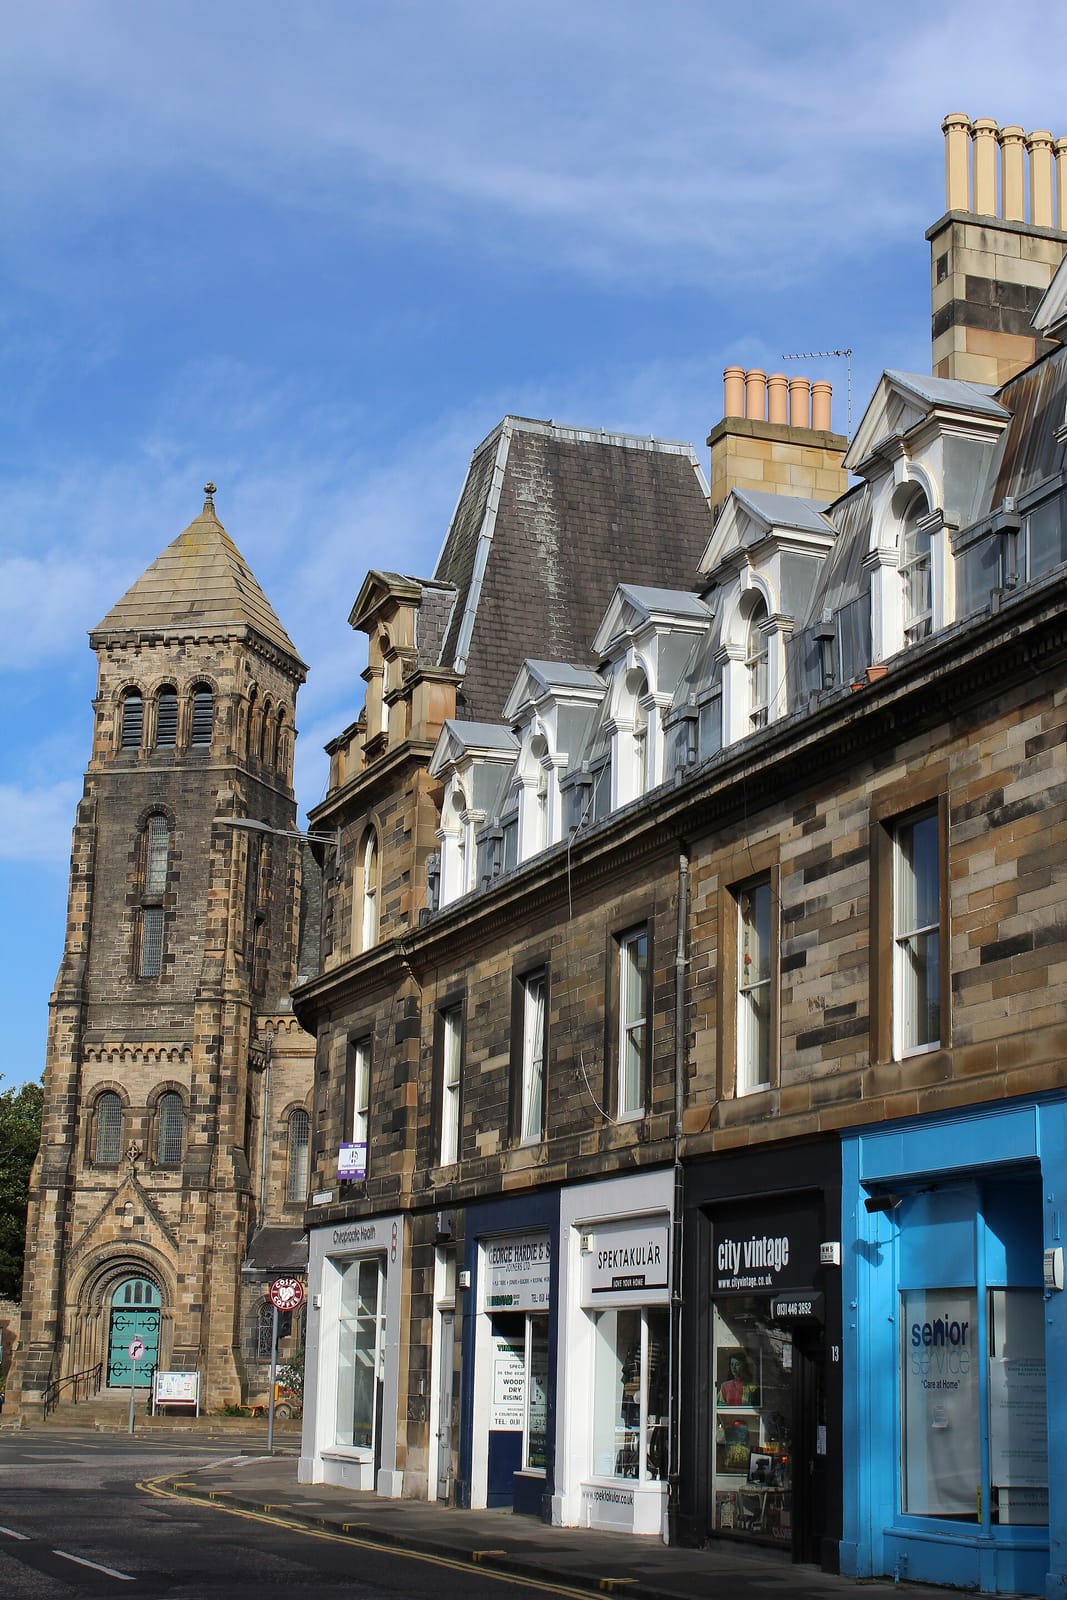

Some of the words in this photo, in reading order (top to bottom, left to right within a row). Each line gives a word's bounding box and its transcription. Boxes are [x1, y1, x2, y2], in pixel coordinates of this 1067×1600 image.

[361, 1225, 376, 1241] Health
[488, 1246, 513, 1264] GEORGE
[514, 1243, 537, 1262] HARDIE
[538, 1242, 544, 1260] &
[598, 1241, 661, 1269] SPEKTAKULÄR
[717, 1239, 741, 1275] city
[743, 1236, 789, 1272] vintage
[505, 1262, 522, 1272] JOINERS
[275, 1278, 297, 1289] COSTA
[717, 1273, 773, 1290] www.cityvintage.co.uk
[273, 1295, 300, 1308] COFFEE
[911, 1313, 969, 1347] senior
[831, 1345, 840, 1362] 13
[911, 1350, 970, 1375] service
